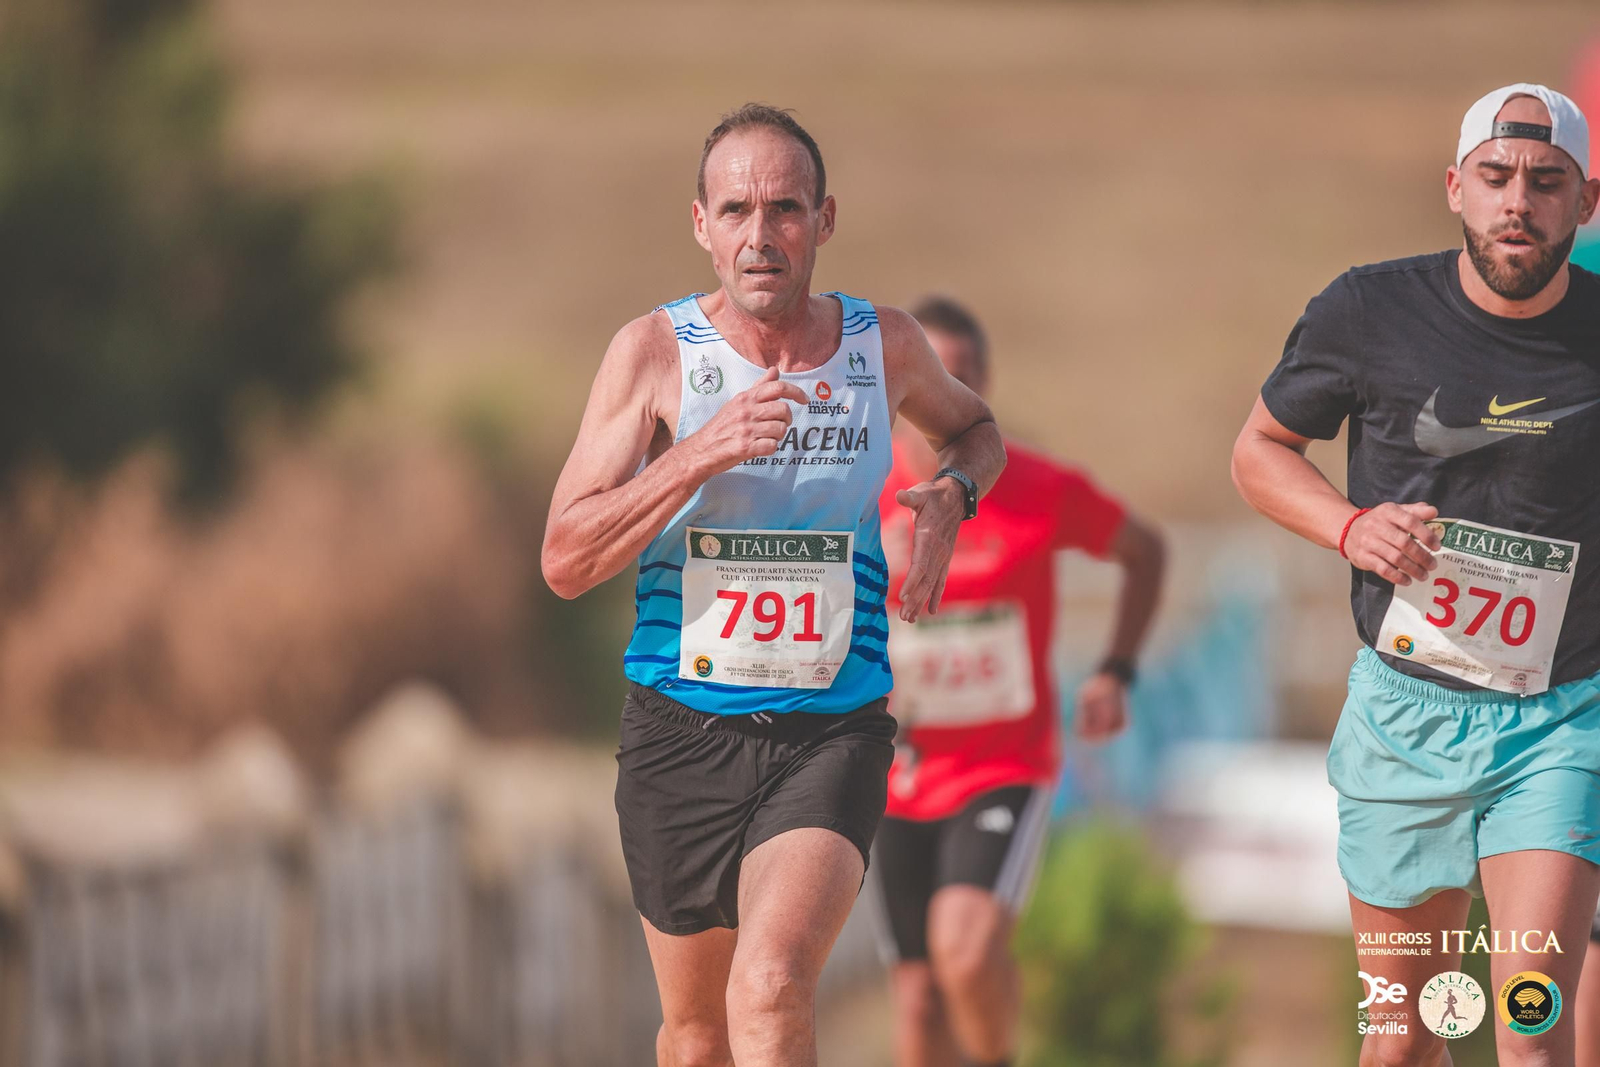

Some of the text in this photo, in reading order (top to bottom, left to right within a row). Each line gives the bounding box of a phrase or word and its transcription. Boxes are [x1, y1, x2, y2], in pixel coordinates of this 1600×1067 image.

[808, 403, 849, 416] mayfo
[1499, 418, 1532, 428] ATHLETIC
[776, 426, 869, 451] ACENA
[738, 456, 855, 466] LUB DE ATLETISMO
[731, 536, 811, 557] ITÁLICA
[1455, 530, 1534, 562] ITÁLICA
[716, 565, 826, 575] FRANCISCO DUARTE SANTIAGO
[1442, 553, 1539, 581] FELIPE CAMACHO MIRANDA
[1459, 567, 1518, 585] INDEPENDIENTE
[741, 574, 784, 582] ATLETISMO
[717, 590, 823, 642] 791
[1426, 577, 1536, 646] 370
